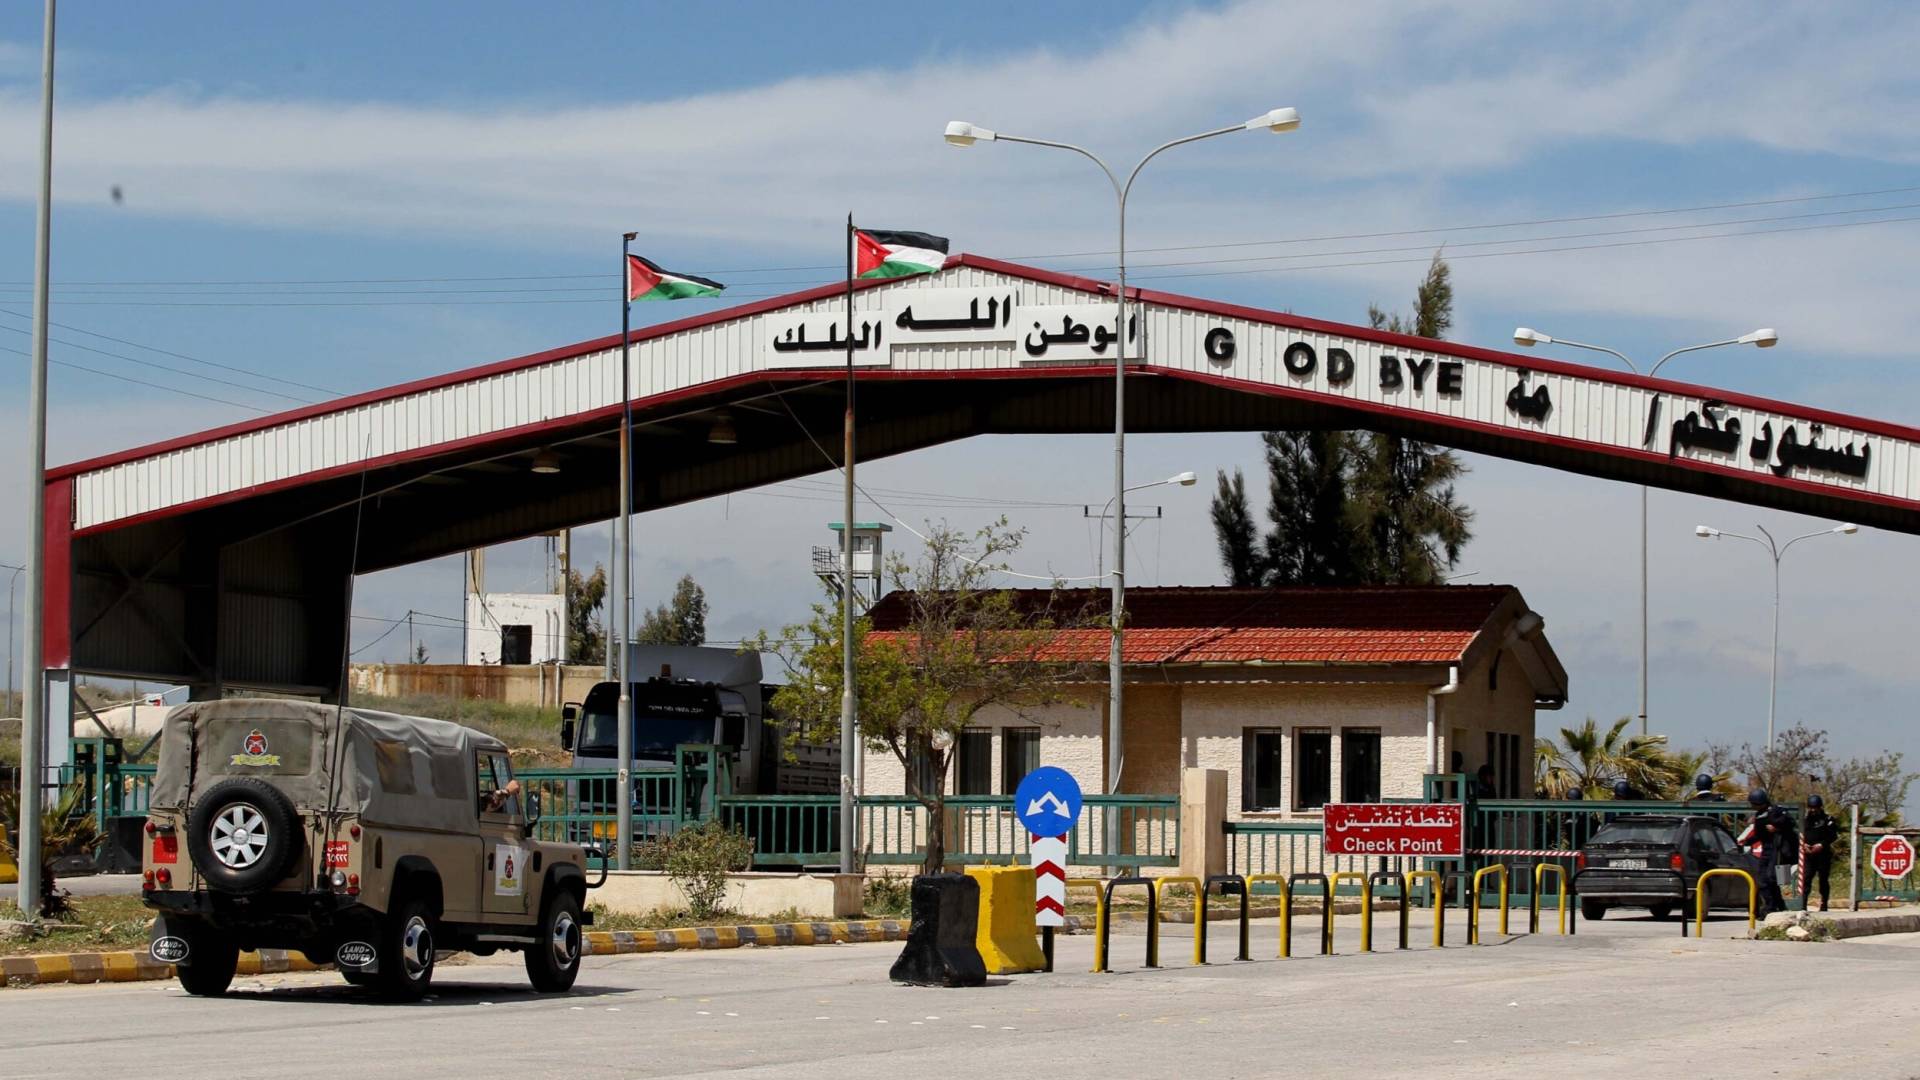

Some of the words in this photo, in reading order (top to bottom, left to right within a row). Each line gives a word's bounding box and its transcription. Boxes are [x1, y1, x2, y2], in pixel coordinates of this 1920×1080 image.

[896, 295, 1011, 330] الله
[774, 320, 882, 351] الملك
[1380, 355, 1463, 395] BYE
[1335, 810, 1402, 832] تفتيش
[1405, 809, 1453, 828] نقطة
[1343, 837, 1396, 852] Check
[1400, 837, 1443, 852] Point
[1879, 841, 1906, 855] قف
[1880, 858, 1906, 870] STOP
